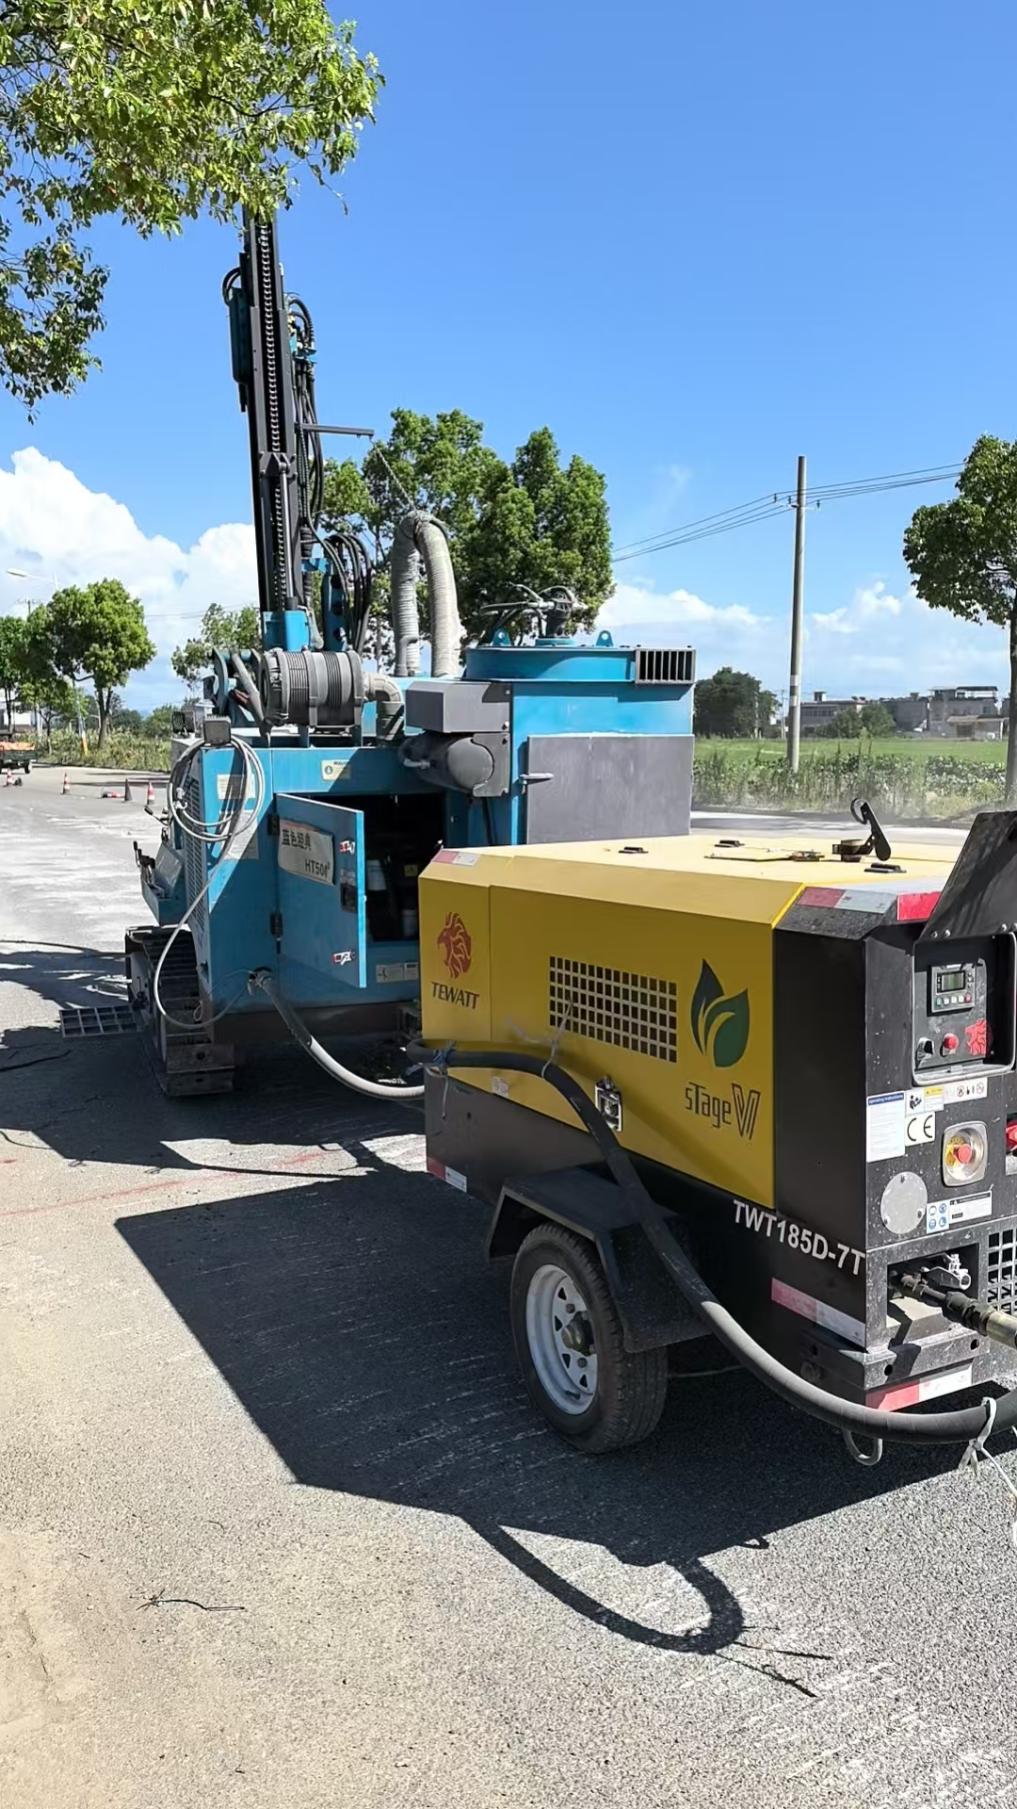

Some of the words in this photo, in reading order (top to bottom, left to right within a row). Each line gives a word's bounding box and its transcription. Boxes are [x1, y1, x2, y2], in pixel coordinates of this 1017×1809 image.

[431, 980, 480, 1010] TEWATT
[907, 1114, 933, 1142] CE
[733, 1199, 866, 1276] TWT185D-7T
